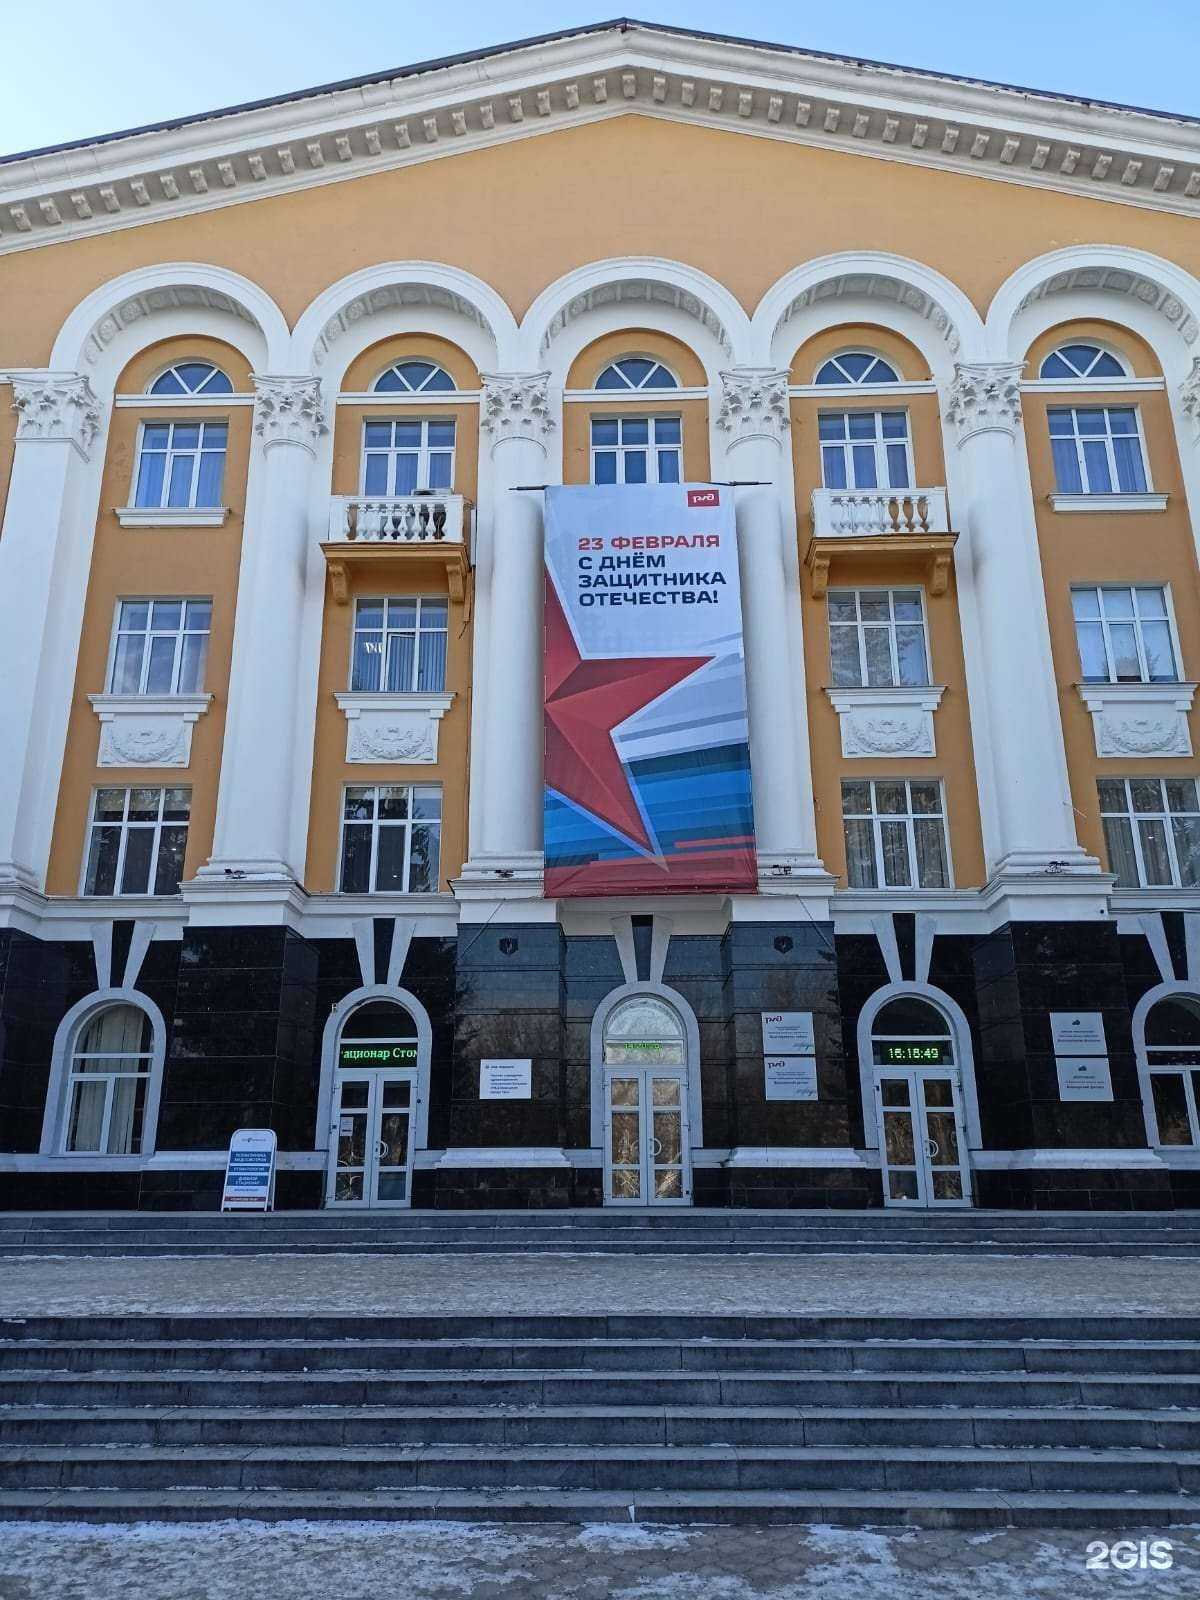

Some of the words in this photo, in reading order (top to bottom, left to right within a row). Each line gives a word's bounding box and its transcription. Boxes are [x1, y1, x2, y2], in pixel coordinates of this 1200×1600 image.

[578, 537, 604, 550] 23
[611, 535, 720, 550] ФЕВРАЛЯ
[578, 557, 593, 570] С
[599, 552, 665, 571] ДНЁМ
[578, 571, 727, 589] ЗАЩИТНИКА
[579, 590, 719, 607] ОТЕЧЕСТВА!
[341, 1050, 391, 1060] ационар
